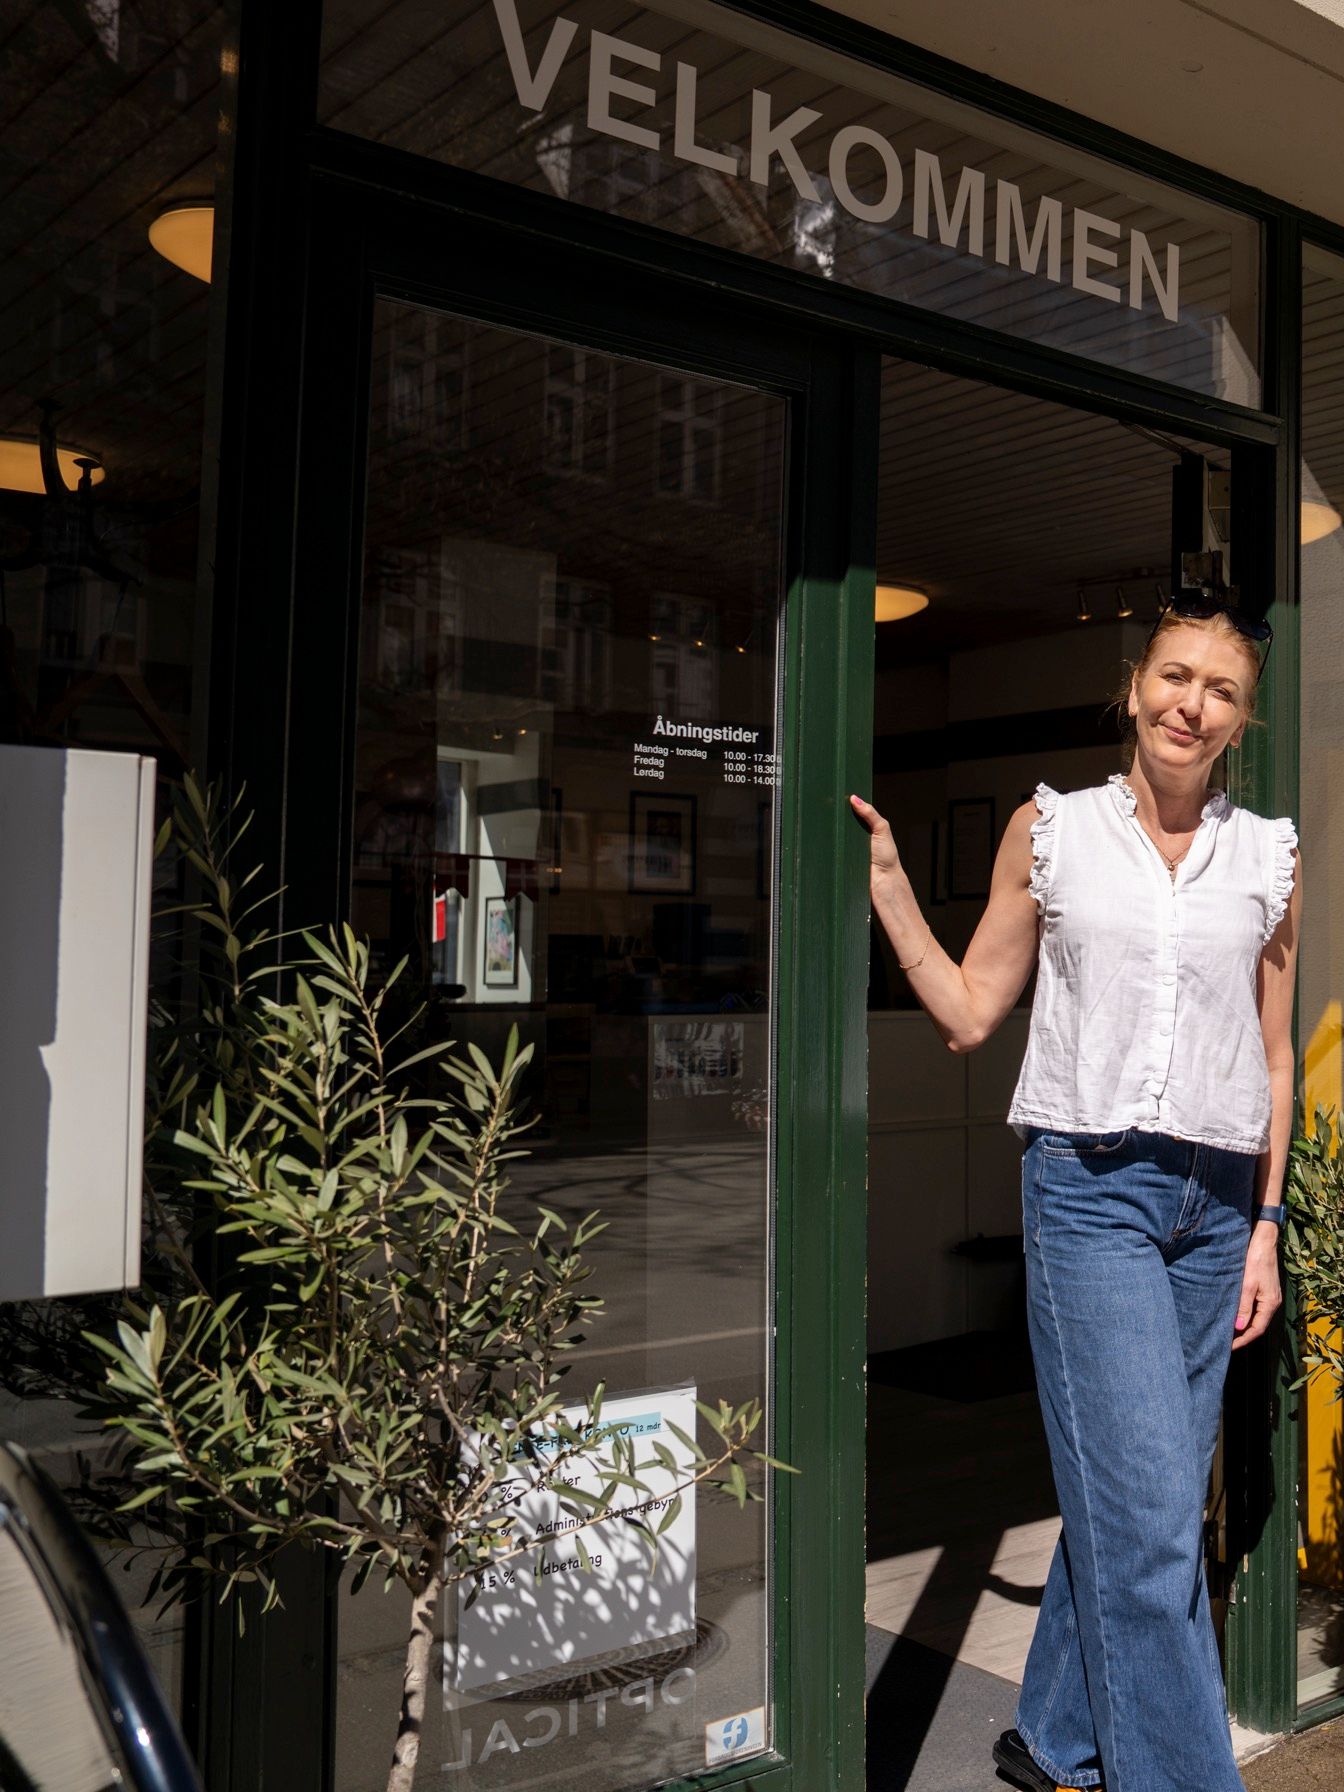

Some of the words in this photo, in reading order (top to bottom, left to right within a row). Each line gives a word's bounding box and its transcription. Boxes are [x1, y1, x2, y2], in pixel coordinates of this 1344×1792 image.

[492, 0, 1180, 322] VELKOMMEN
[653, 715, 759, 743] Åbningstider
[634, 743, 668, 756] Mandag
[676, 747, 707, 759] torsdag
[724, 751, 746, 760] 10.00
[753, 753, 776, 763] 17.30
[634, 755, 664, 767] Fredag
[724, 762, 746, 772] 10.00
[753, 765, 776, 774] 18.30
[634, 767, 664, 779] Lørdag
[724, 774, 746, 783] 10.00
[753, 776, 776, 785] 14.00
[635, 1423, 644, 1432] 12
[646, 1421, 661, 1431] mdr
[537, 1474, 581, 1493] Rter
[536, 1497, 675, 1535] Administtions-gebyr
[504, 1570, 515, 1584] %
[533, 1554, 602, 1577] Udbetalng
